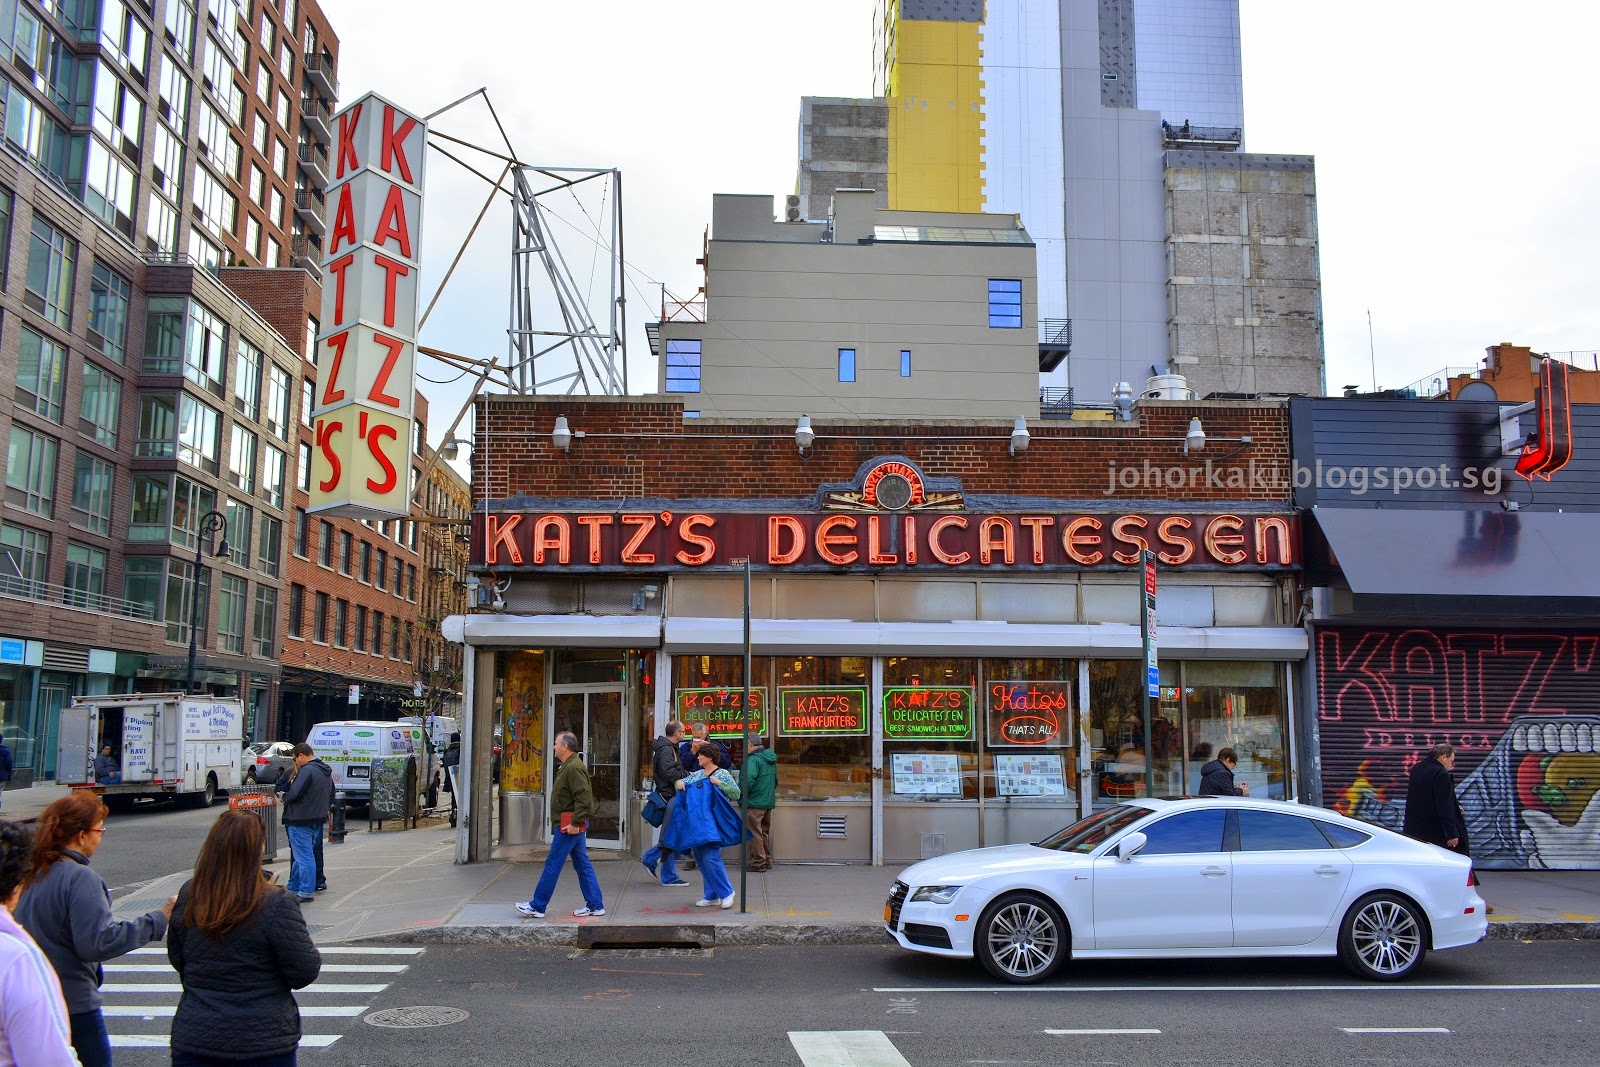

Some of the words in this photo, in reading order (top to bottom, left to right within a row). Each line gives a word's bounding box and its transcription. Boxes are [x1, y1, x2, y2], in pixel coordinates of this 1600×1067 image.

[316, 103, 363, 493] KATZ'S
[359, 104, 417, 495] KATZ'S
[865, 467, 884, 501] KATZ'S
[486, 510, 717, 565] KATZ'S
[767, 514, 1292, 565] DELICATESSEN
[797, 695, 850, 713] KATZ'S
[893, 689, 961, 709] KATZ'S
[789, 715, 857, 728] FRANKFURTERS
[892, 709, 963, 722] DELICATESSEN
[737, 723, 759, 731] BST
[889, 724, 905, 732] BEST
[907, 725, 939, 733] SANDWICH
[948, 724, 967, 733] TOWN
[1038, 725, 1053, 735] ALL
